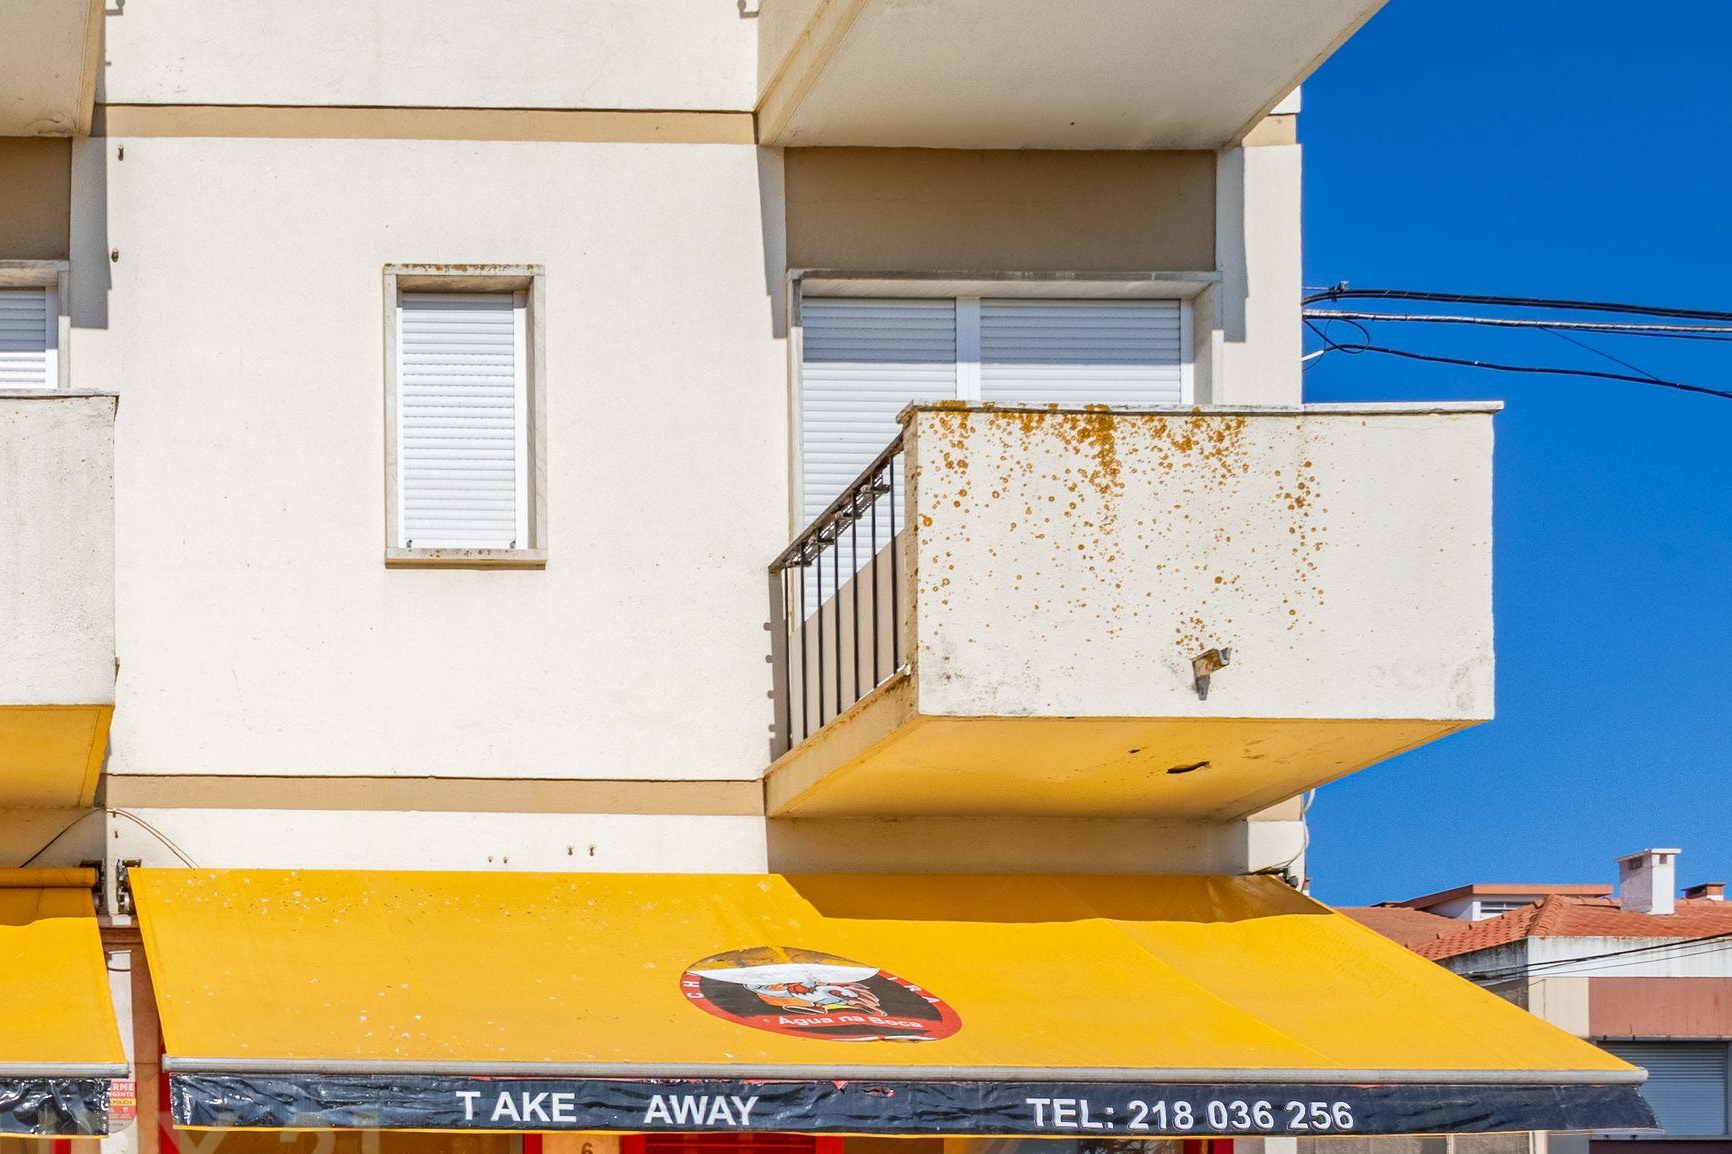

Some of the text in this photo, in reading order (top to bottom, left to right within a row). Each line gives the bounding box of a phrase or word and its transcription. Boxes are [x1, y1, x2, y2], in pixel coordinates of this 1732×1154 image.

[779, 1015, 923, 1029] Água na Boca
[643, 1094, 759, 1126] AWAY
[1025, 1097, 1355, 1132] TEL: 218 036 256
